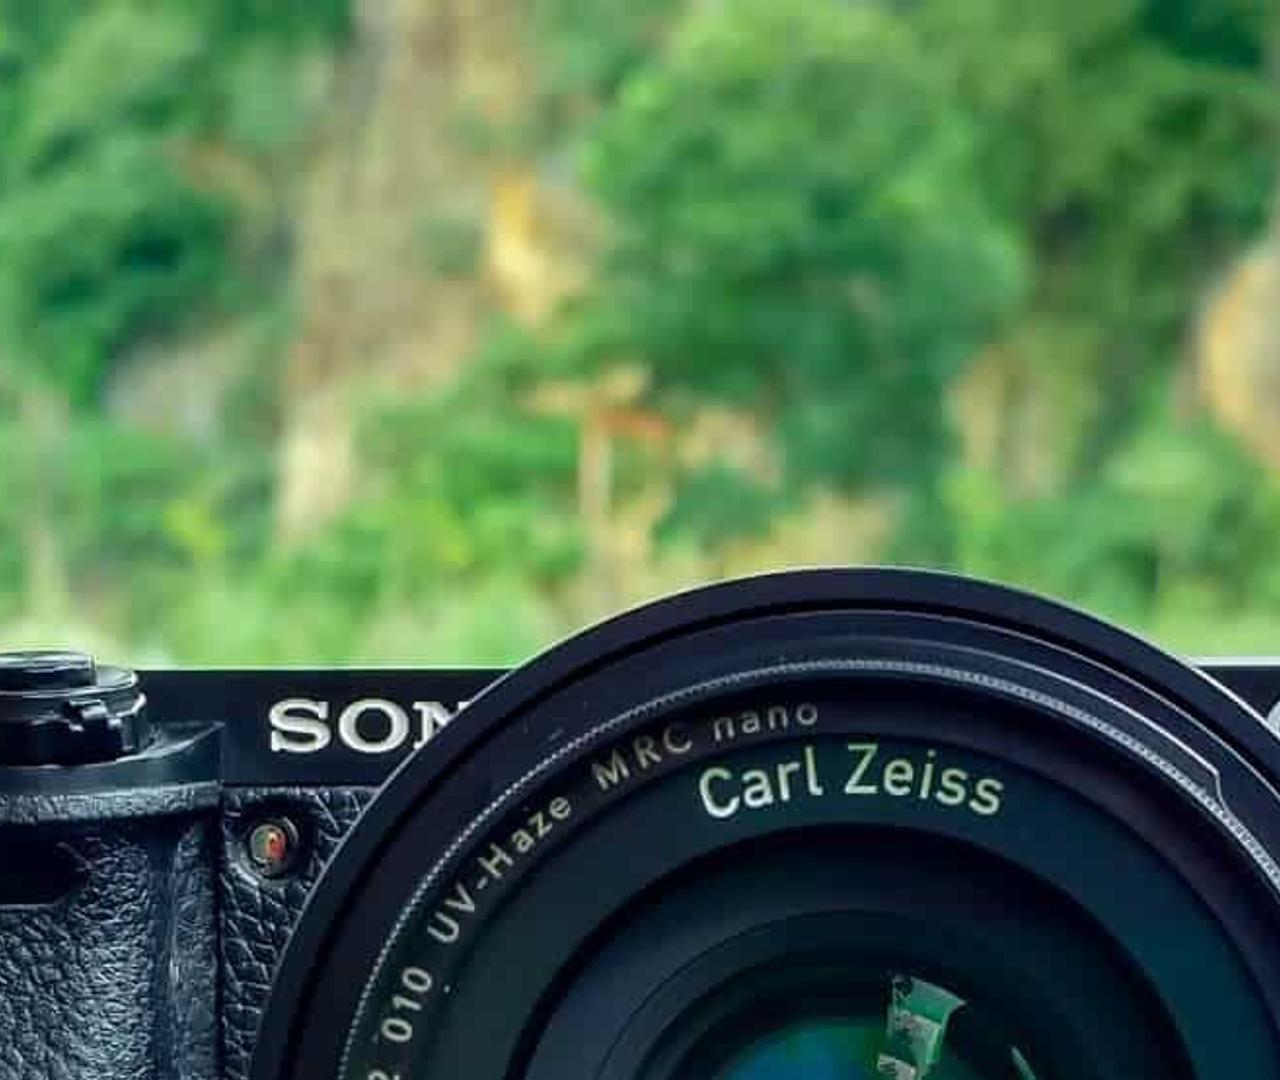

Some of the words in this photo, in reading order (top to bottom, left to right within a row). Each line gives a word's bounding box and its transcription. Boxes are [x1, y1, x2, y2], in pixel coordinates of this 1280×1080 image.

[268, 698, 476, 753] SON
[698, 744, 824, 819] Carl
[843, 741, 1005, 815] Zeiss
[381, 966, 432, 1043] 010
[426, 796, 571, 943] UV-Haze
[591, 723, 693, 791] MRC
[712, 701, 819, 742] nano
